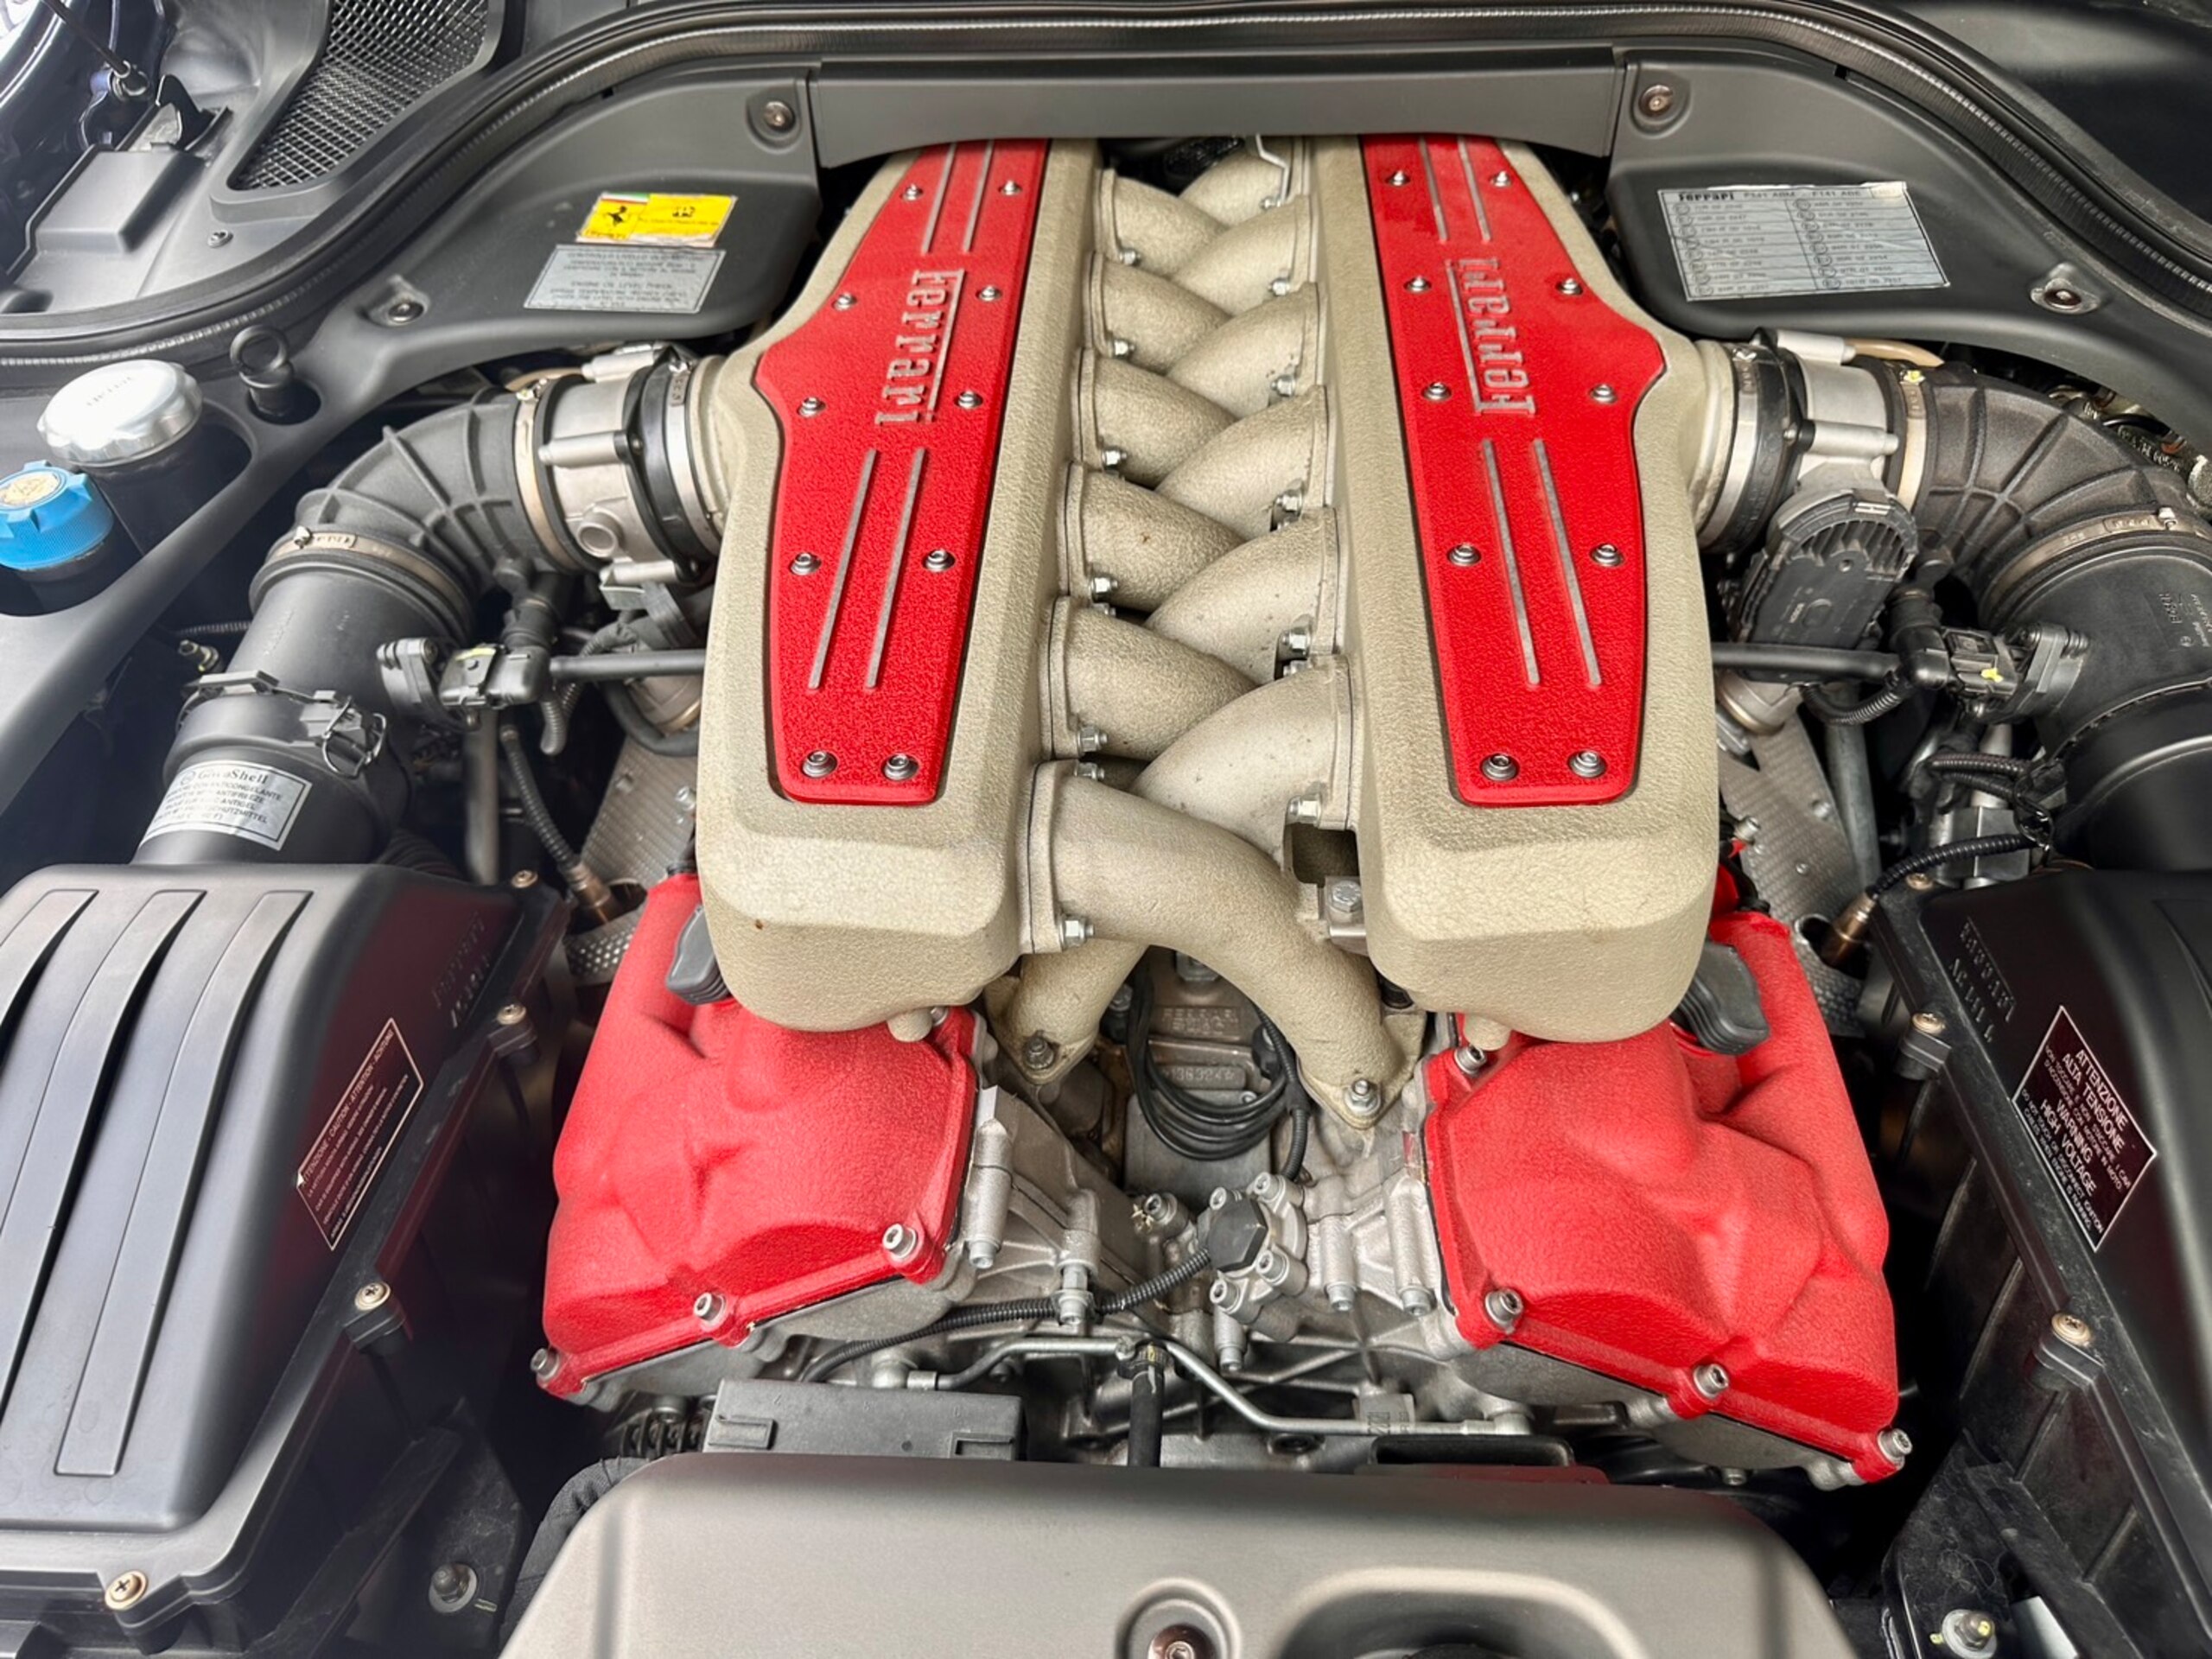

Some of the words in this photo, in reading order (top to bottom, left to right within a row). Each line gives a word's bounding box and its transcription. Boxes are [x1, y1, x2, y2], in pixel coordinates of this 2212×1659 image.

[1677, 192, 1735, 201] Ferrari
[874, 267, 965, 426] Ferrari
[1445, 257, 1536, 418] Ferrari
[328, 1102, 349, 1139] CAUTION
[350, 1061, 372, 1103] ATTENTION
[2055, 1098, 2093, 1164] WARNING
[2062, 1051, 2082, 1085] ALTA
[2081, 1082, 2125, 1154] TENSIONE
[2075, 1046, 2128, 1131] ATTENZIONE
[2040, 1098, 2060, 1135] HIGH
[2060, 1133, 2096, 1198] VOLTAGE
